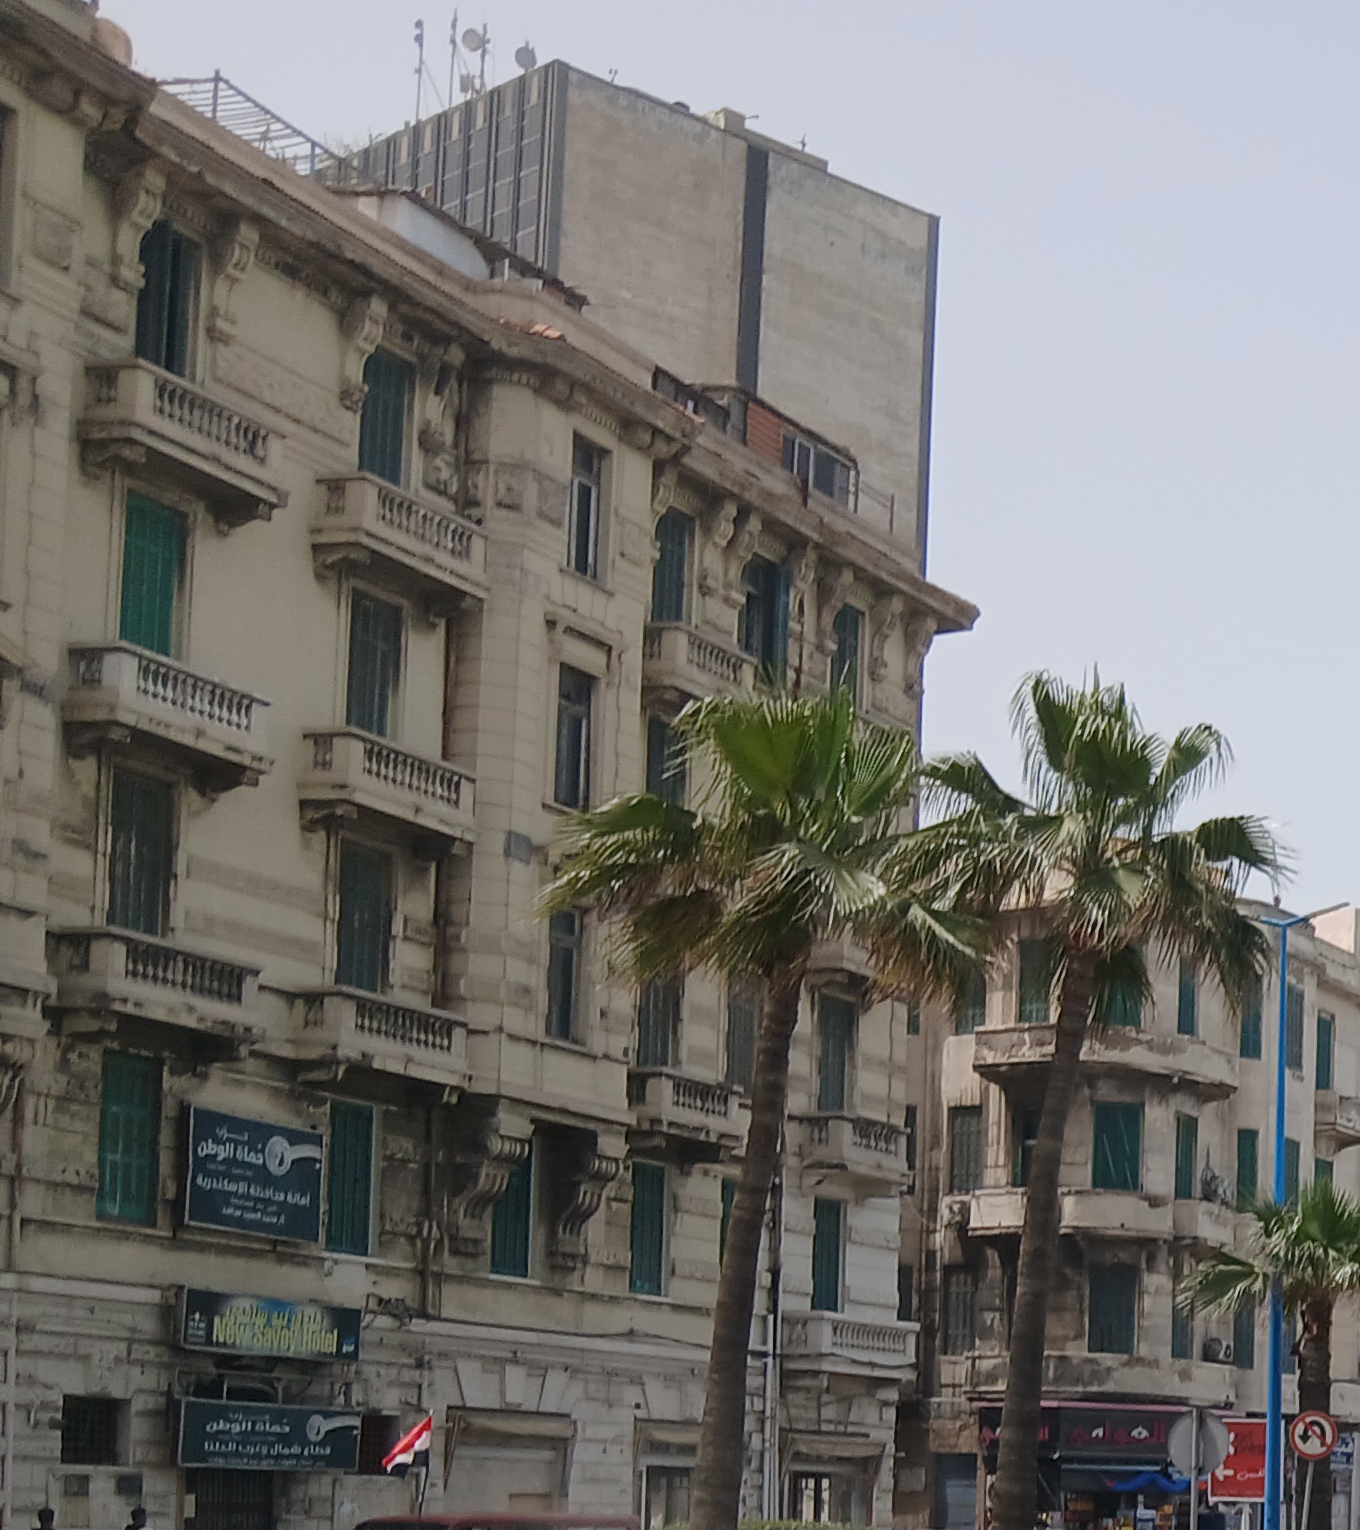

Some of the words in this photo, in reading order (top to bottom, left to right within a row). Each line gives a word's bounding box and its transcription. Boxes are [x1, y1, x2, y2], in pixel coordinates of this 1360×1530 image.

[197, 1138, 235, 1161] الوطن
[213, 1314, 249, 1346] New
[254, 1322, 298, 1355] Savoy
[302, 1327, 338, 1355] Hotel
[205, 1418, 252, 1434] الوطن
